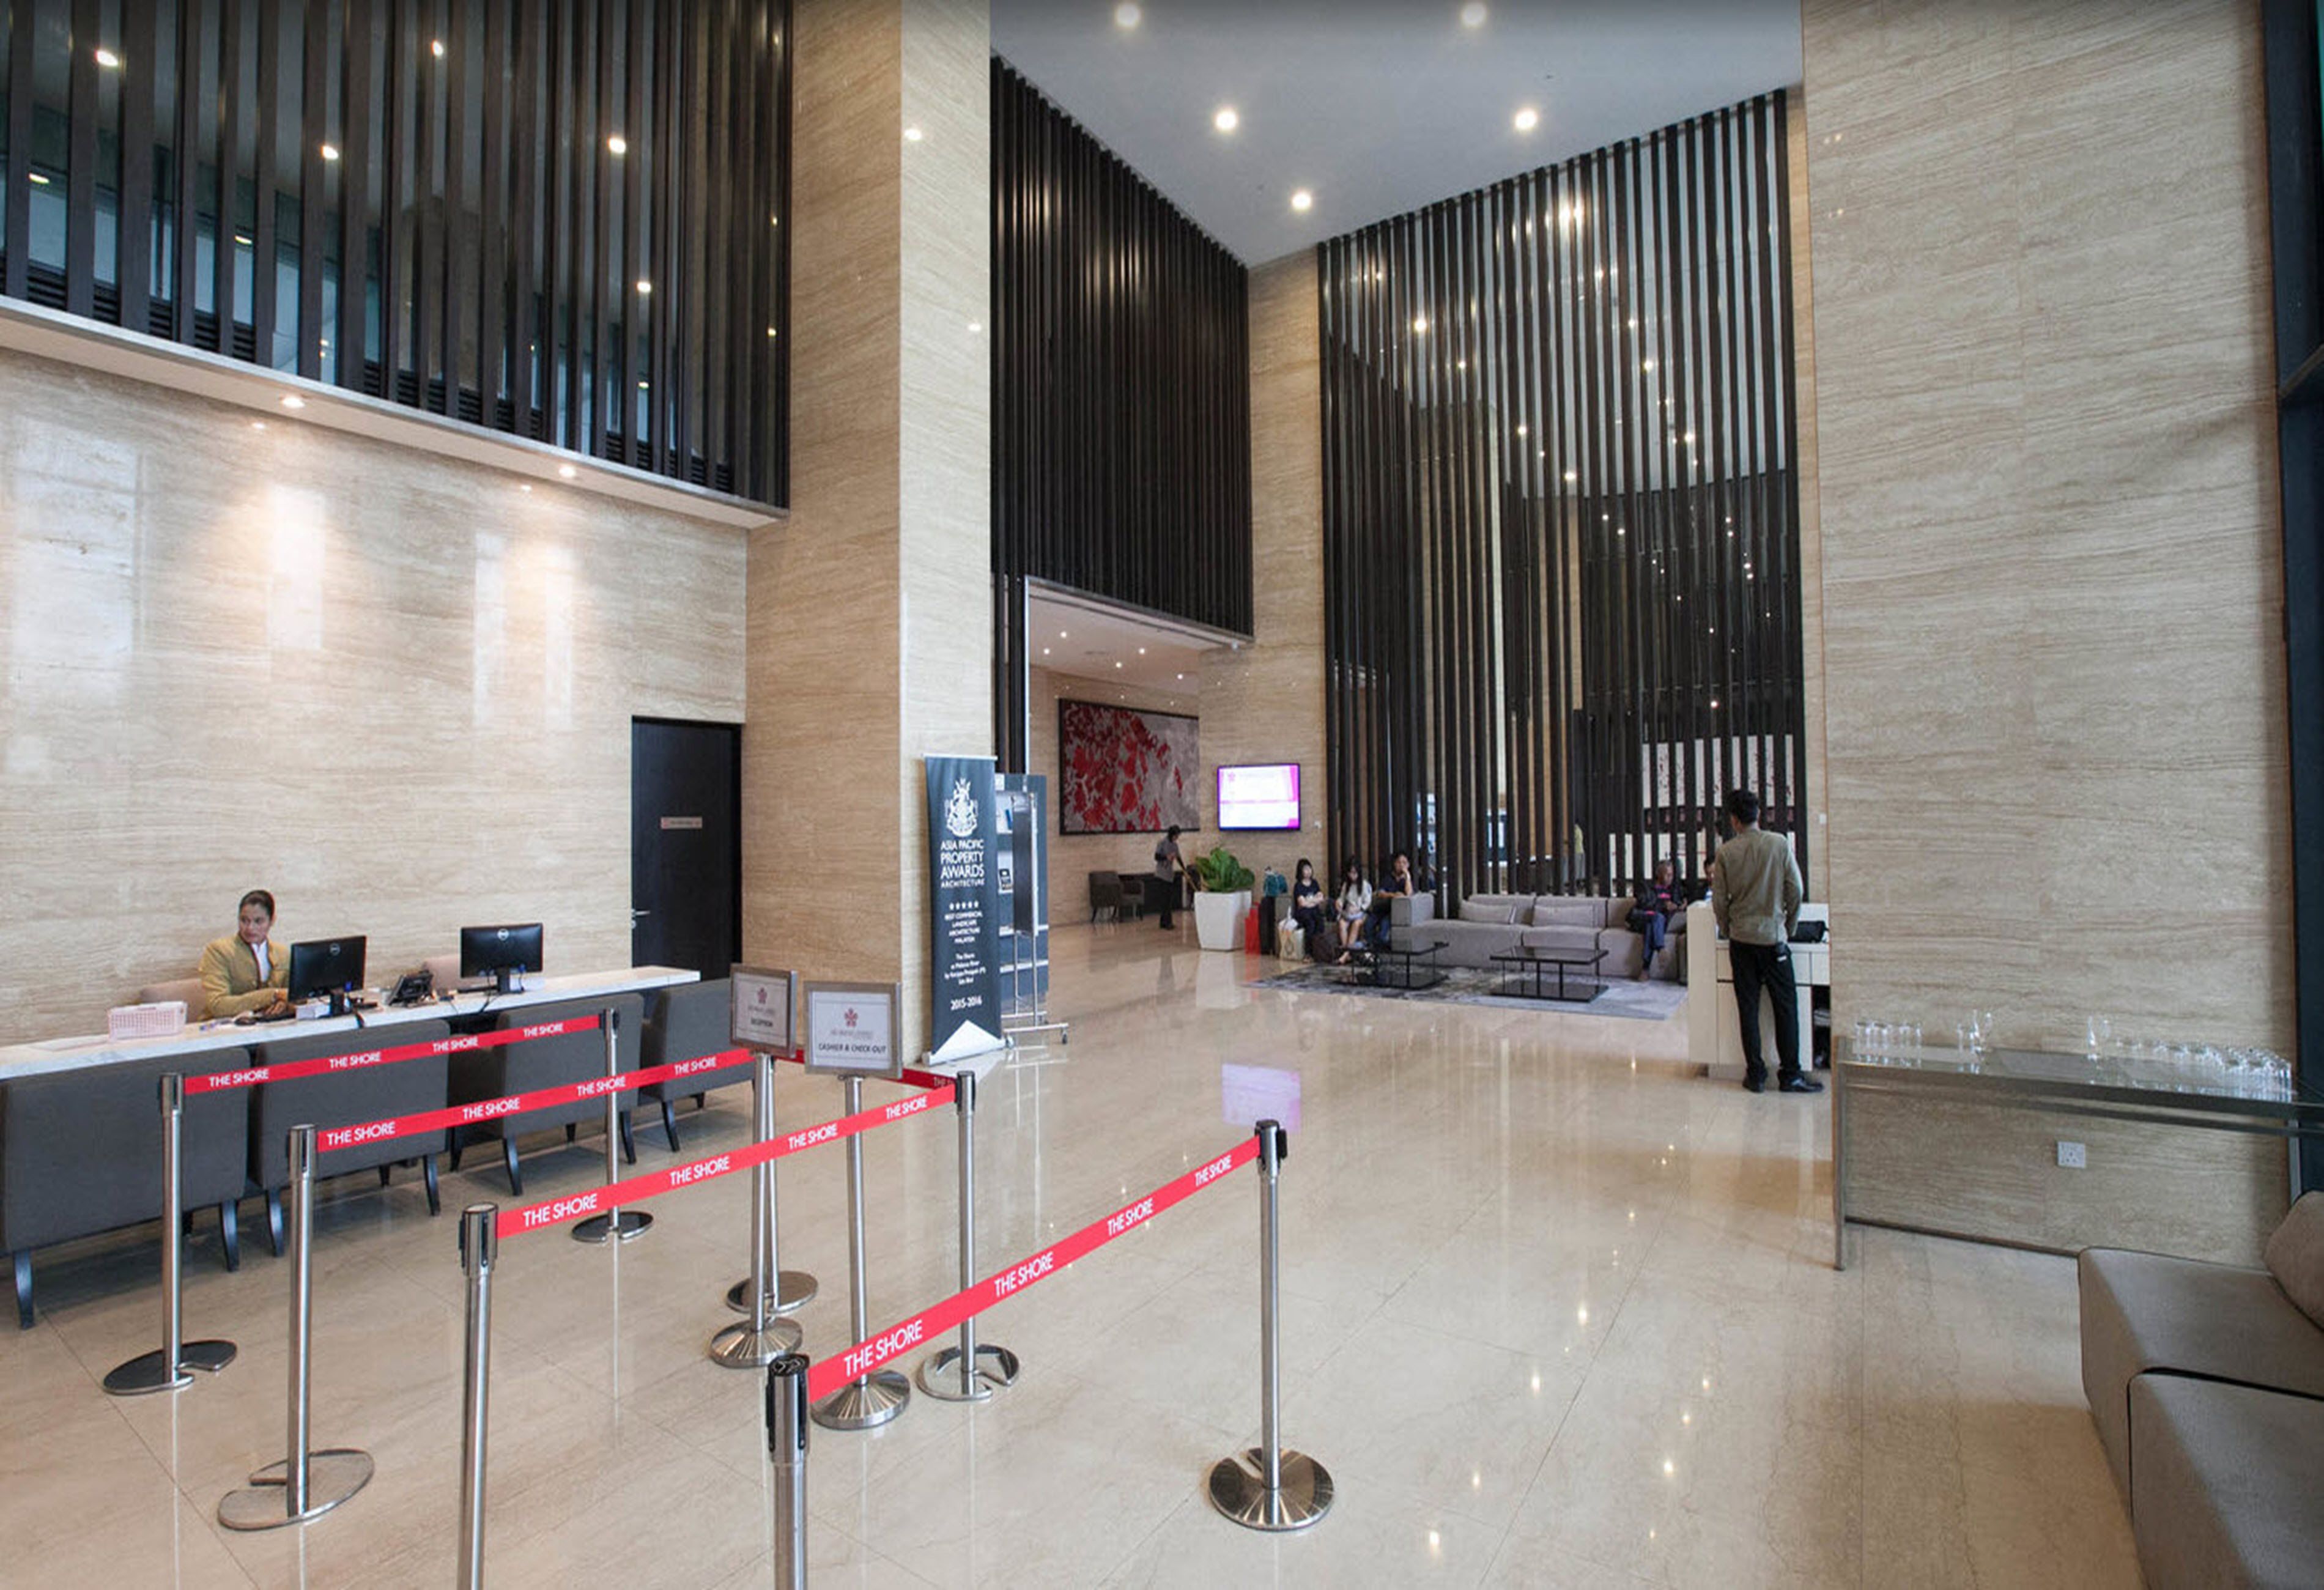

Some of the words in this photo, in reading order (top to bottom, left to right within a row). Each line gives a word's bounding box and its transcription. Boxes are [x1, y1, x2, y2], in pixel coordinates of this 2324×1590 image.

[941, 840, 958, 850] ASIA
[959, 839, 984, 849] PACIFIC
[941, 851, 984, 864] PROPERTY
[941, 864, 984, 879] AWARDS
[941, 879, 985, 889] ARCHITECTURE
[950, 995, 982, 1011] 2015-2016
[524, 1027, 538, 1037] THE
[539, 1023, 563, 1034] SHORE
[432, 1041, 449, 1052] THE
[450, 1037, 478, 1050] SHORE
[329, 1057, 348, 1068] THE
[350, 1051, 380, 1066] SHORE
[675, 1062, 689, 1074] THE
[690, 1056, 716, 1071] SHORE
[210, 1074, 231, 1087] THE
[232, 1068, 268, 1084] SHORE
[577, 1082, 594, 1096] THE
[596, 1076, 626, 1093] SHORE
[462, 1104, 483, 1120] THE
[485, 1098, 520, 1116] SHORE
[886, 1104, 901, 1119] THE
[902, 1095, 927, 1115] SHORE
[327, 1130, 352, 1145] THE
[354, 1121, 395, 1141] SHORE
[788, 1133, 807, 1150] THE
[807, 1123, 838, 1144] SHORE
[670, 1166, 692, 1186] THE
[693, 1156, 730, 1180] SHORE
[1195, 1167, 1209, 1187] THE
[1208, 1155, 1232, 1179] SHORE
[523, 1205, 550, 1227] THE
[552, 1193, 598, 1219] SHORE
[1107, 1213, 1125, 1236] THE
[1125, 1197, 1153, 1226] SHORE
[994, 1270, 1017, 1297] THE
[1018, 1251, 1054, 1285] SHORE
[843, 1344, 873, 1377] THE
[875, 1319, 923, 1361] SHORE
